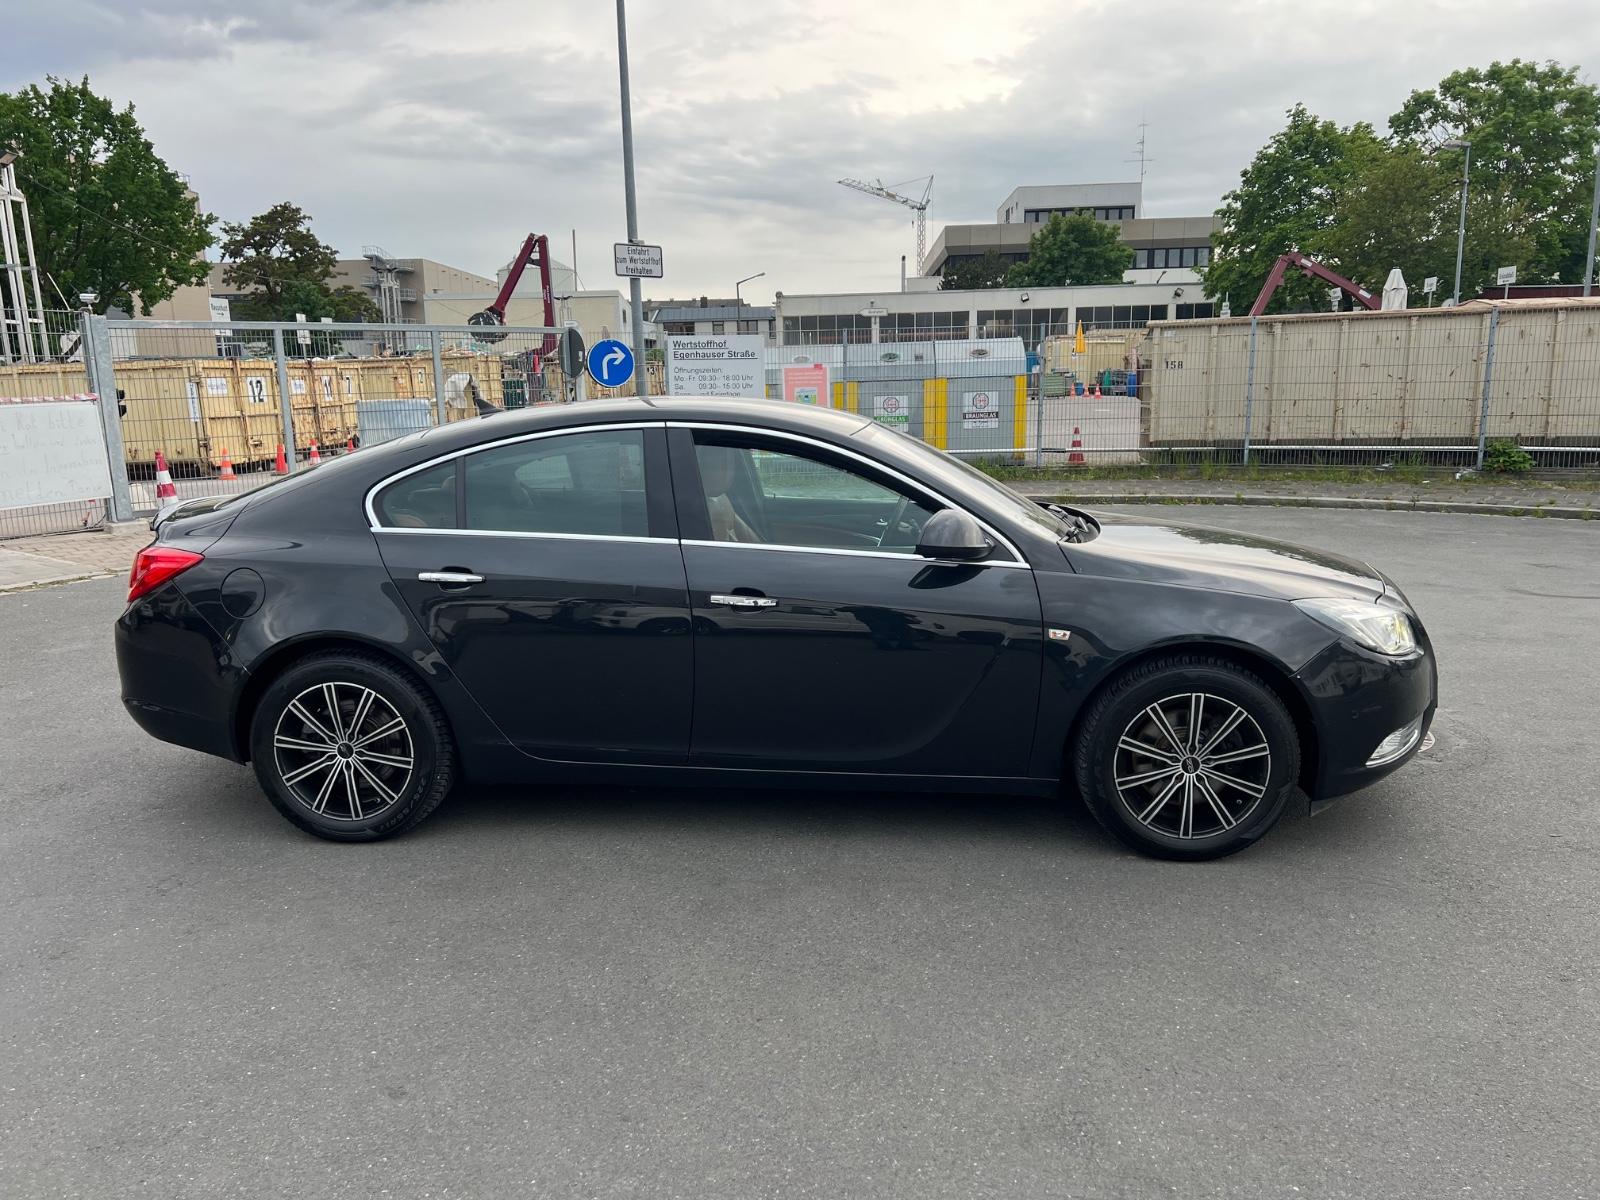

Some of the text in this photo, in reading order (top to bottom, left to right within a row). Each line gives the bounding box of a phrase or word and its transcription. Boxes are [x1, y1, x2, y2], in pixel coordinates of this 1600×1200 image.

[627, 247, 650, 255] Einfahrt
[629, 256, 661, 265] Wertstoffhof
[625, 266, 653, 275] freihalten
[672, 340, 728, 348] Wertstoffhof
[673, 350, 756, 359] Egenhauser Straße
[1165, 360, 1184, 369] 158
[249, 380, 264, 403] 12
